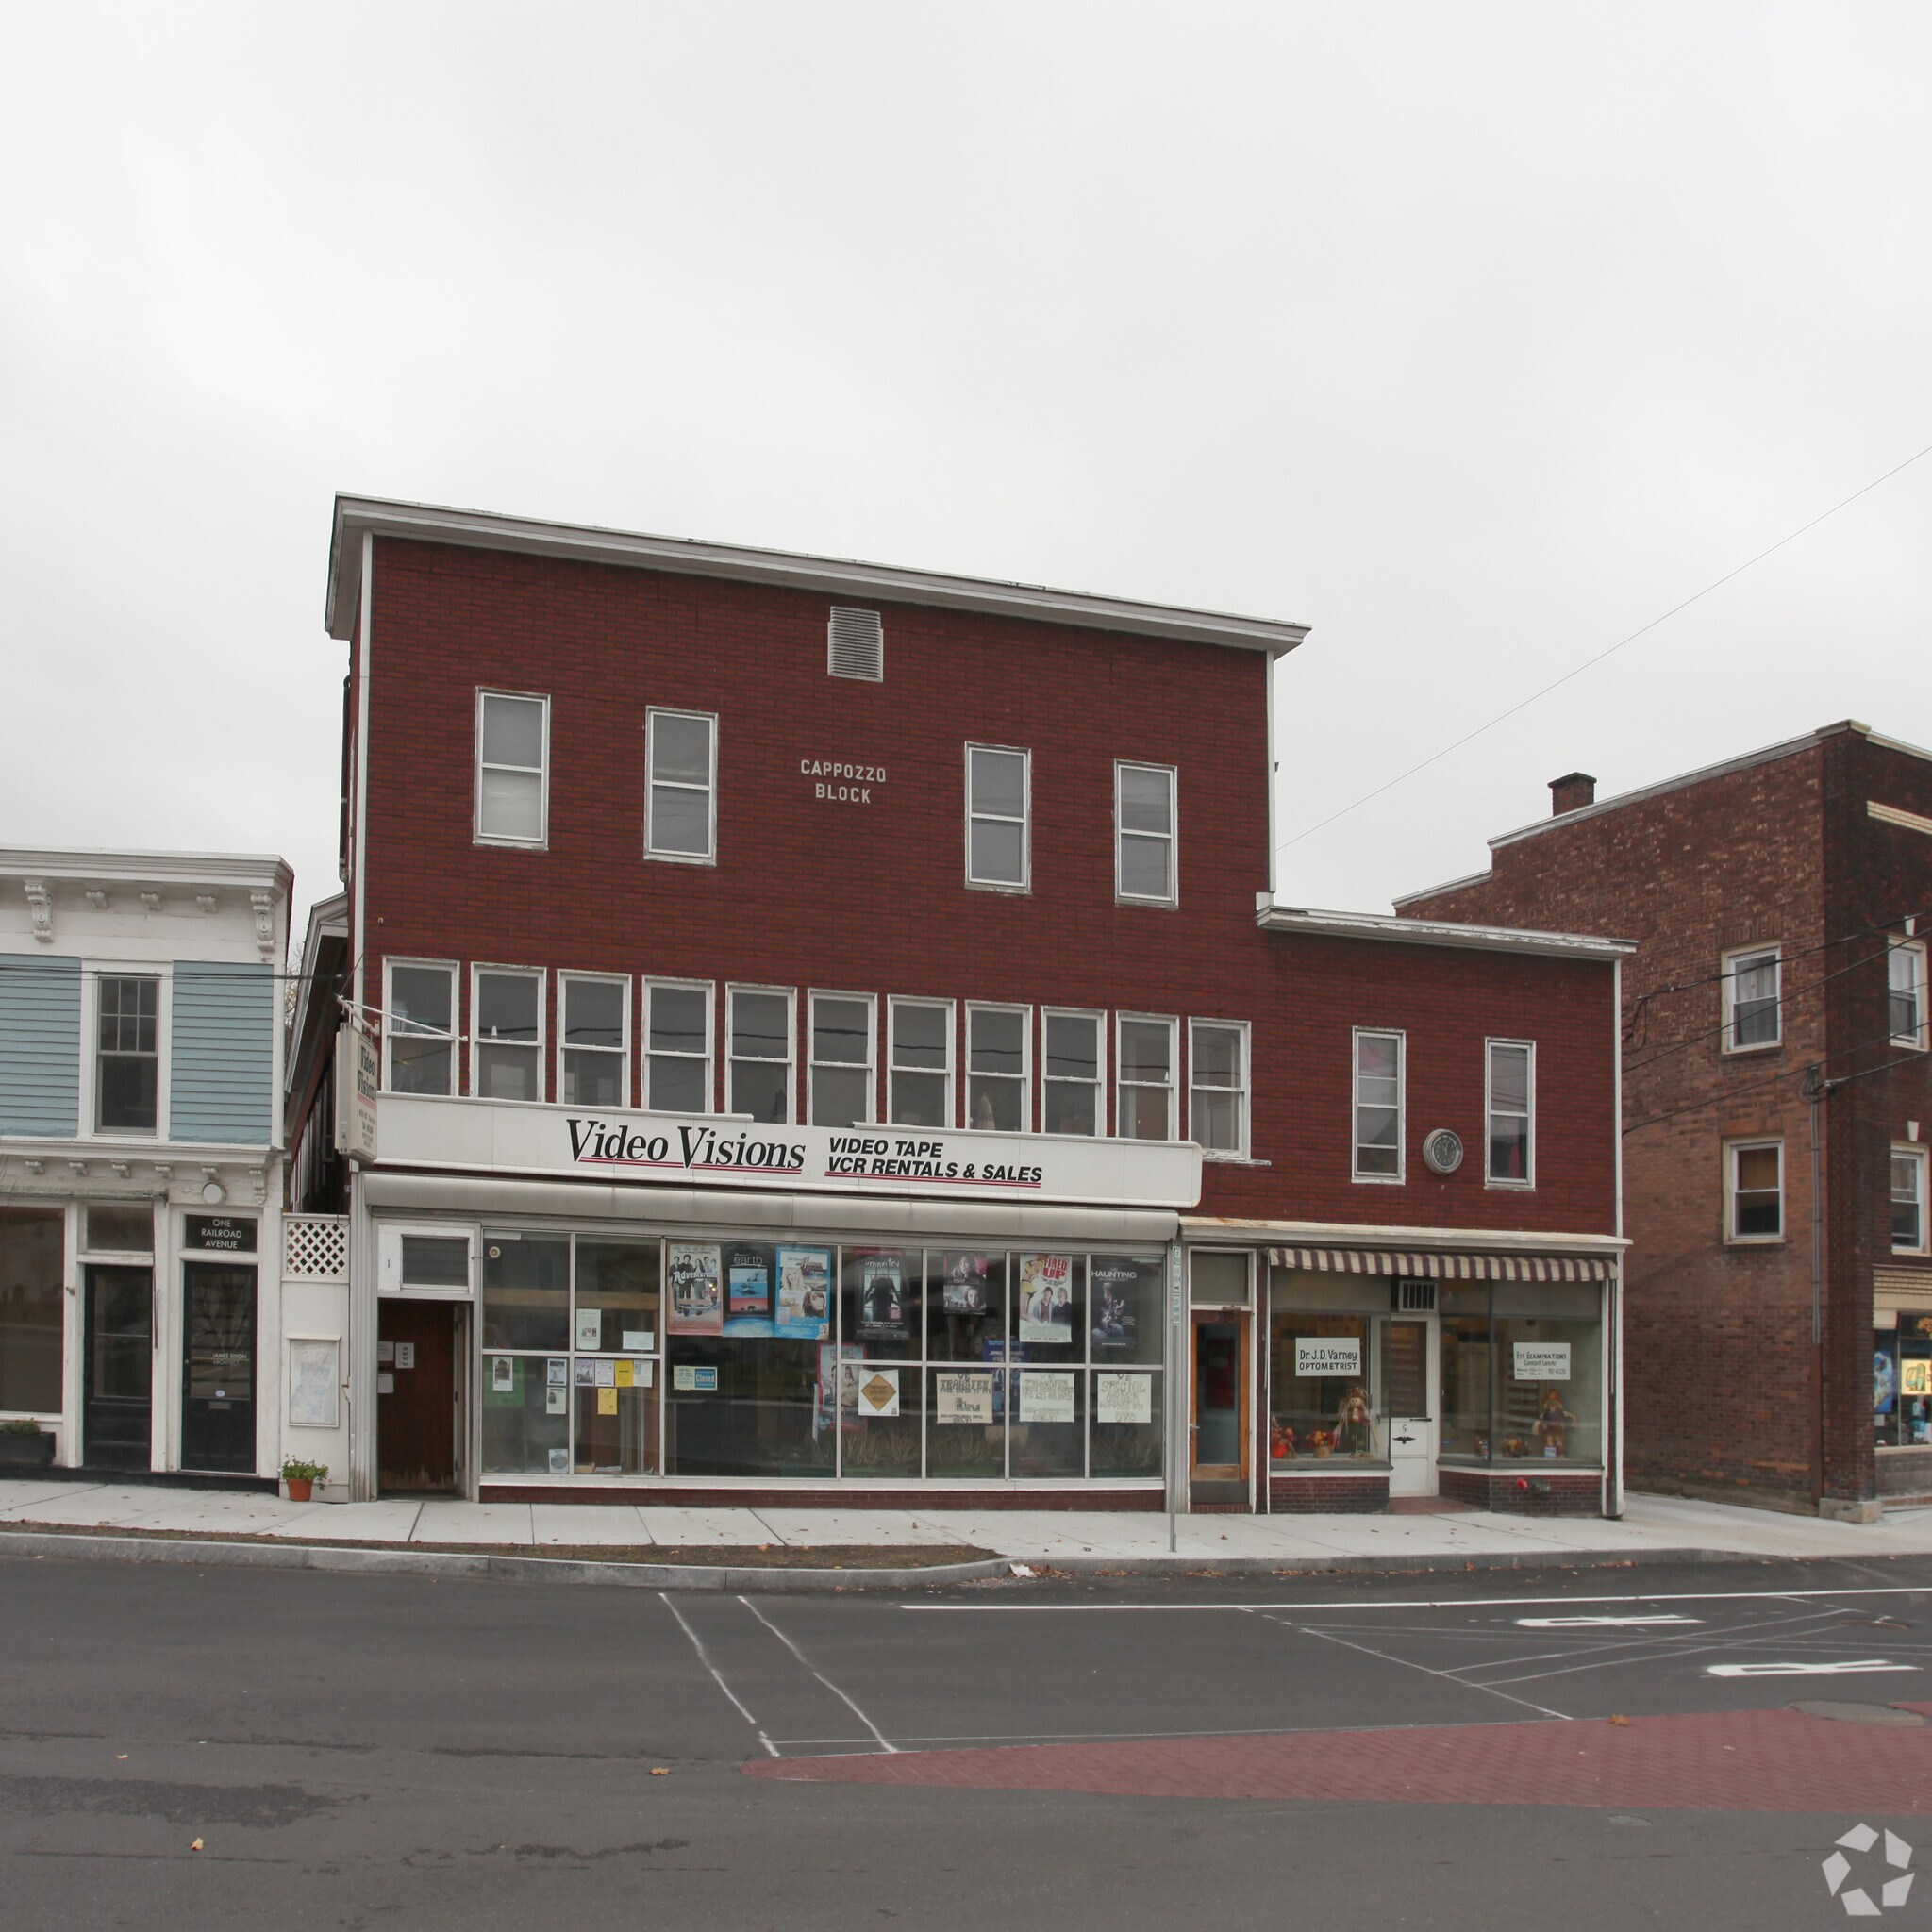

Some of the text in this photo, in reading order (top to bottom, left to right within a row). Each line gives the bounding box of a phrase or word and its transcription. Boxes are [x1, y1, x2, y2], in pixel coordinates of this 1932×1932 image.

[800, 759, 886, 783] CAPPOZZO
[815, 783, 871, 804] BLOCK
[361, 1045, 375, 1075] Video
[566, 1119, 806, 1169] Video Visions
[829, 1137, 944, 1158] VIDEO TAPE
[827, 1157, 1042, 1183] VCR RENTALS & SALES
[212, 1218, 232, 1227] ONE
[201, 1228, 242, 1239] RAILROAD
[205, 1240, 238, 1249] AVENUE
[733, 1255, 763, 1266] earth
[1043, 1257, 1068, 1271] FIRED
[1042, 1267, 1066, 1280] UP
[1091, 1270, 1137, 1279] HAUNTING
[1300, 1349, 1310, 1359] Dr.
[1327, 1349, 1357, 1361] Varney
[695, 1374, 715, 1383] Closed
[1403, 1424, 1407, 1434] 5
